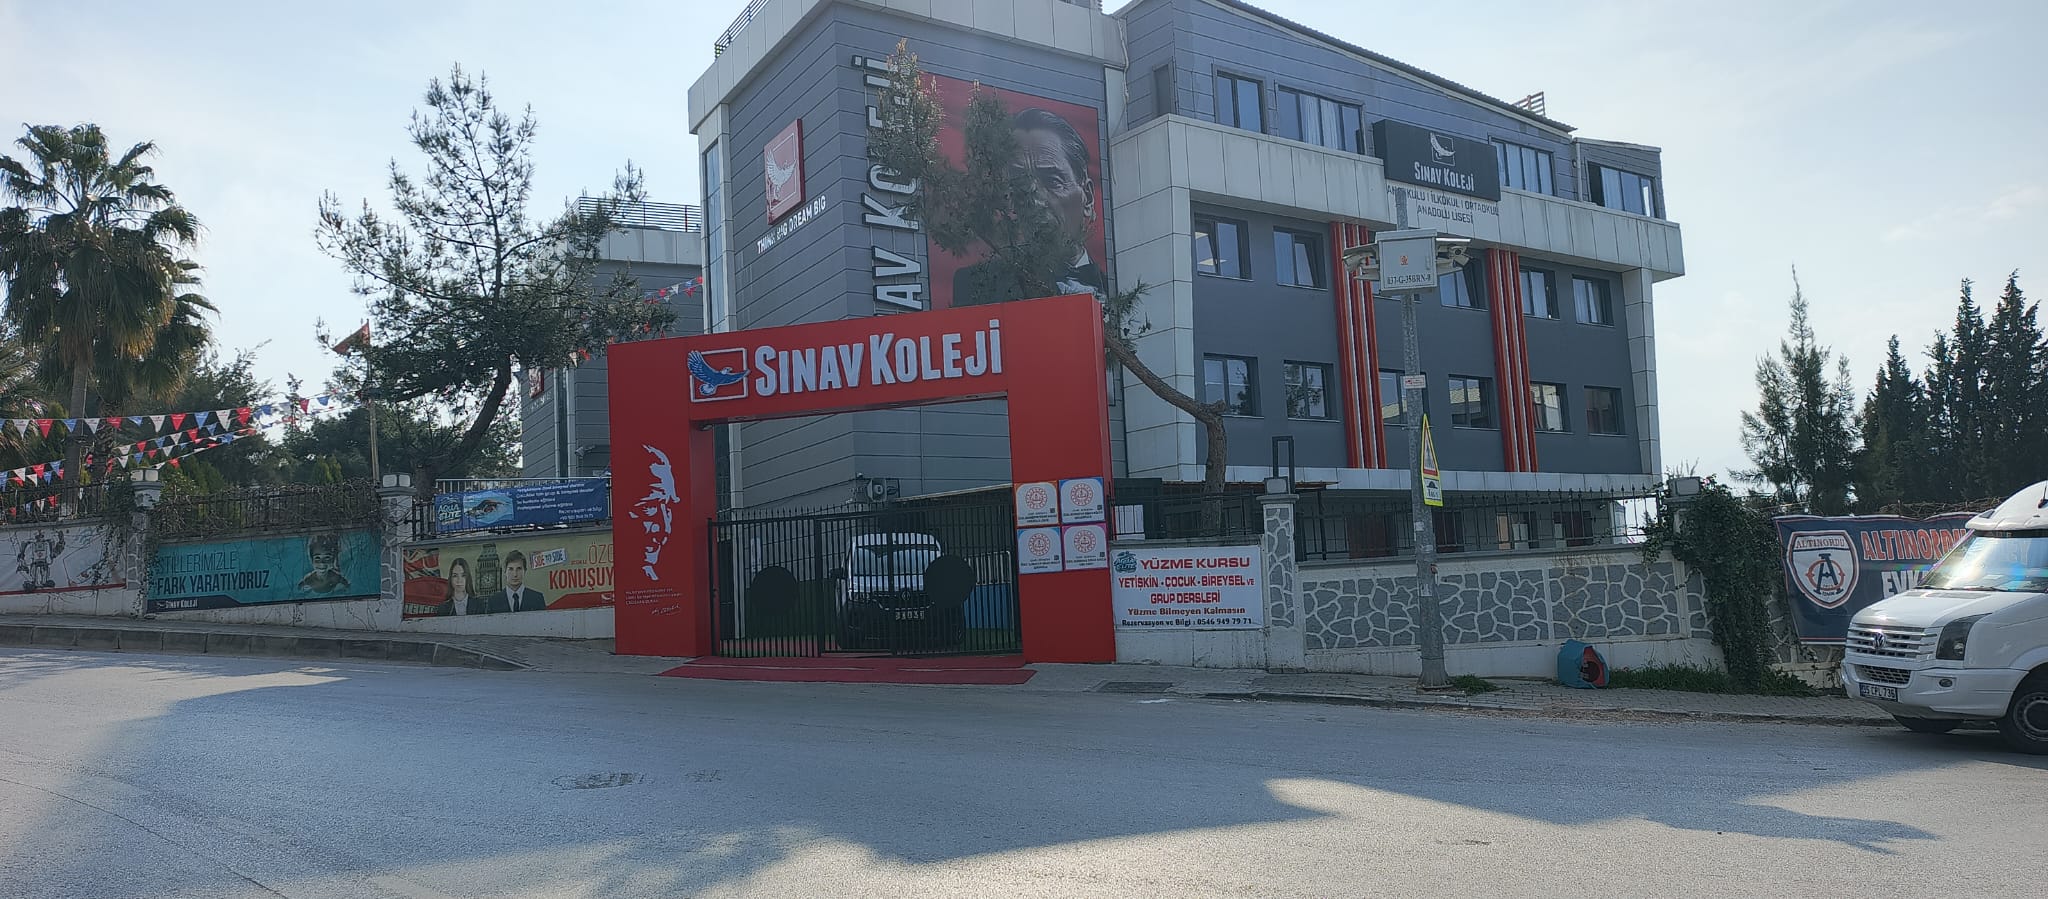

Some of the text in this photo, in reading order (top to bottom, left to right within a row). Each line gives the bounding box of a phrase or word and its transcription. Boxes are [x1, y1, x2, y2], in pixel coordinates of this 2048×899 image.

[1415, 161, 1475, 192] SINAV KOLEJİ
[788, 204, 813, 233] DREAM
[813, 195, 826, 216] BIG
[1417, 204, 1451, 220] ANADOLU
[754, 318, 1003, 397] SINAV KOLEJİ
[1796, 538, 1845, 549] ALTINORDU
[1141, 557, 1250, 570] YÜZME KURSU
[157, 569, 270, 595] FARK YARATIYORUZ
[1119, 575, 1158, 591] YETİŞKİN
[1165, 576, 1196, 590] ÇOCUK
[1202, 573, 1245, 586] BİREYSEL
[1151, 590, 1220, 604] GRUP DERSLERİ
[1128, 607, 1245, 616] Yüzme Bilmeyen Kalmasın
